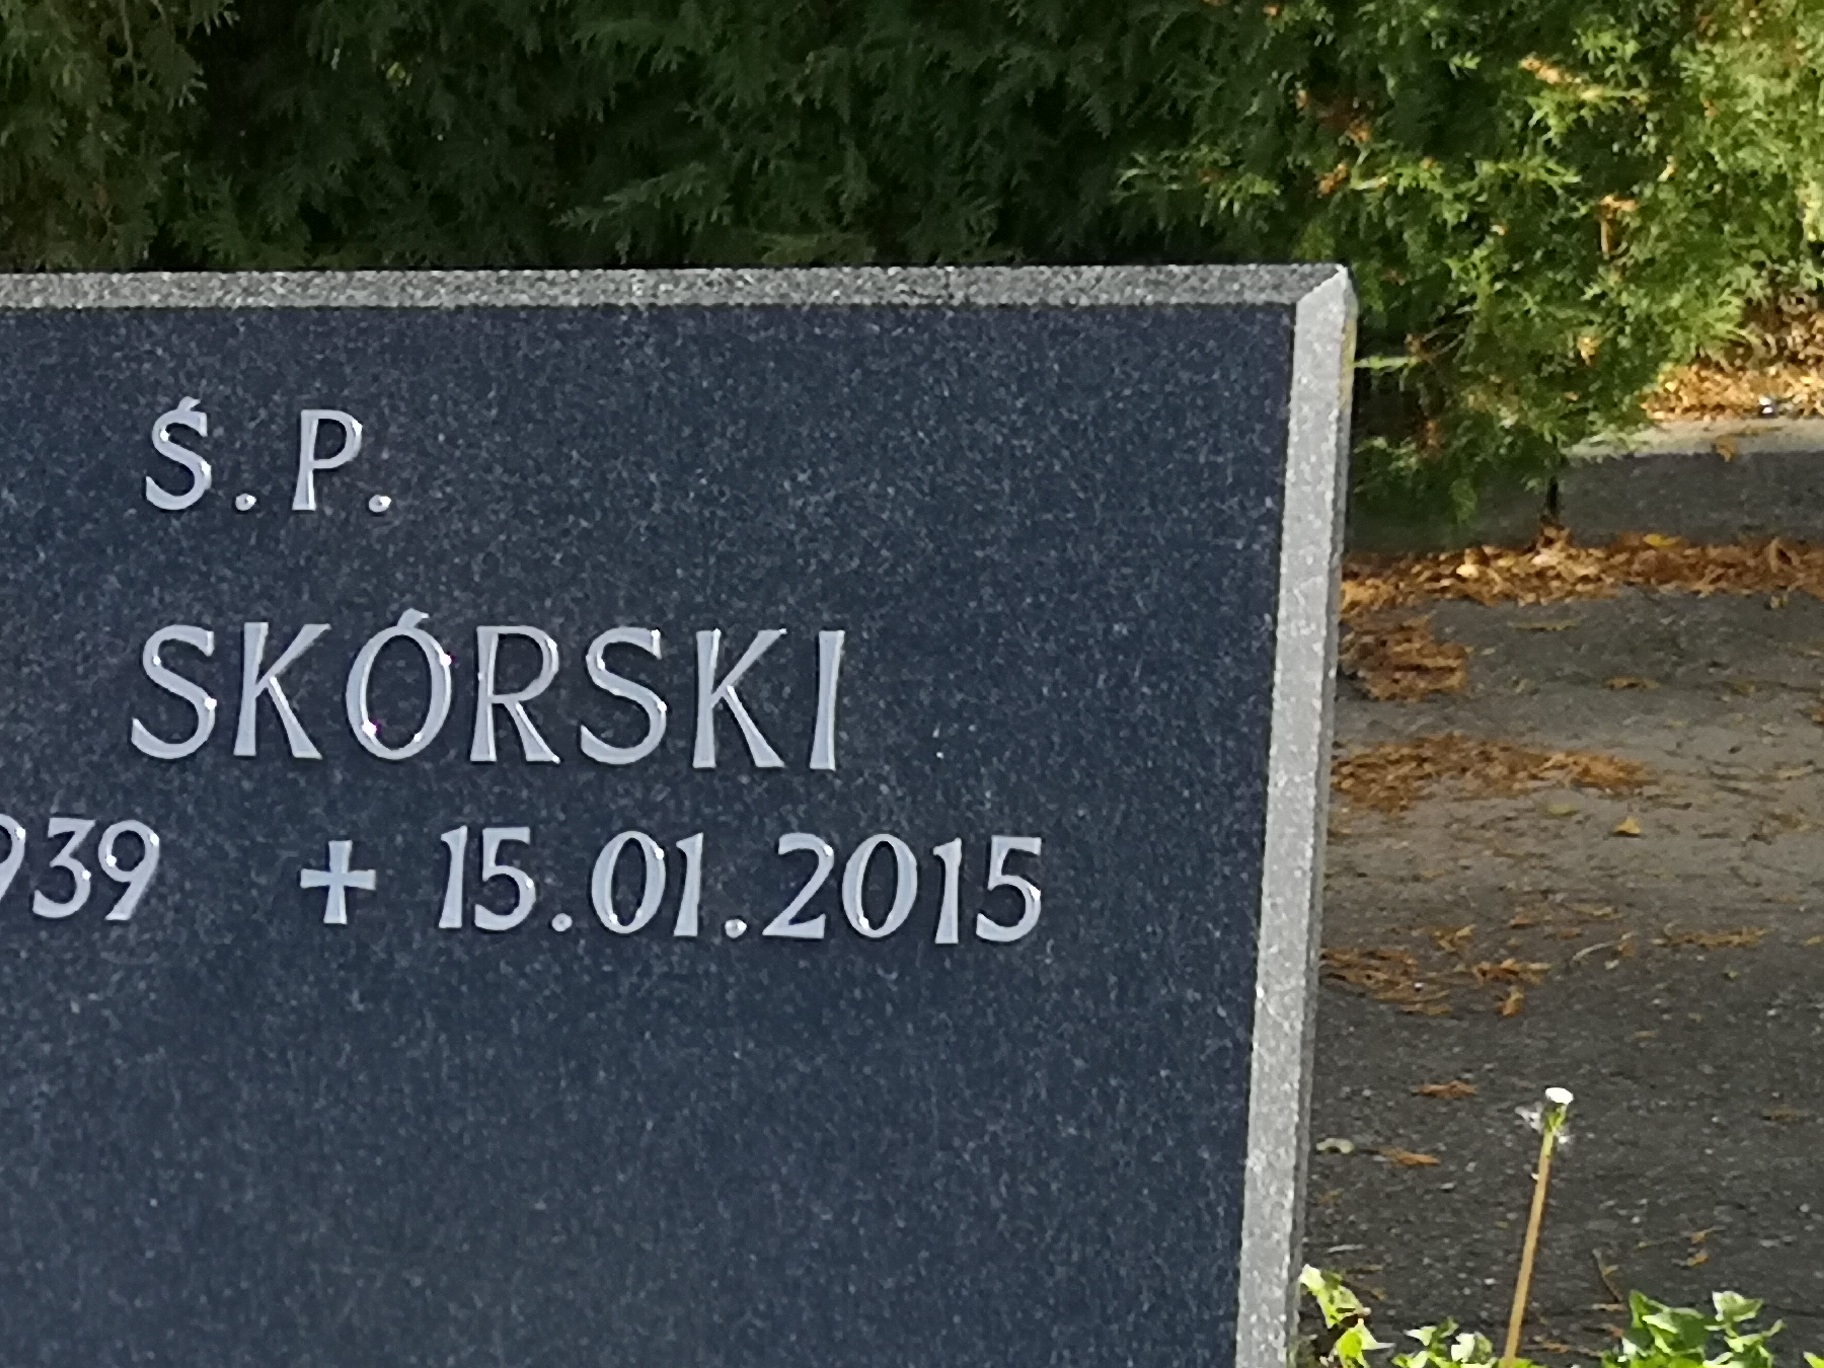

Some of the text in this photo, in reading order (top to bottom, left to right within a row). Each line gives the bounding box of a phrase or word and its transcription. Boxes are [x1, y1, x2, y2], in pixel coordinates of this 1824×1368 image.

[145, 397, 392, 512] Ś.P.
[131, 608, 846, 770] SKÓRSKI
[439, 824, 1044, 942] 15.01.2015
